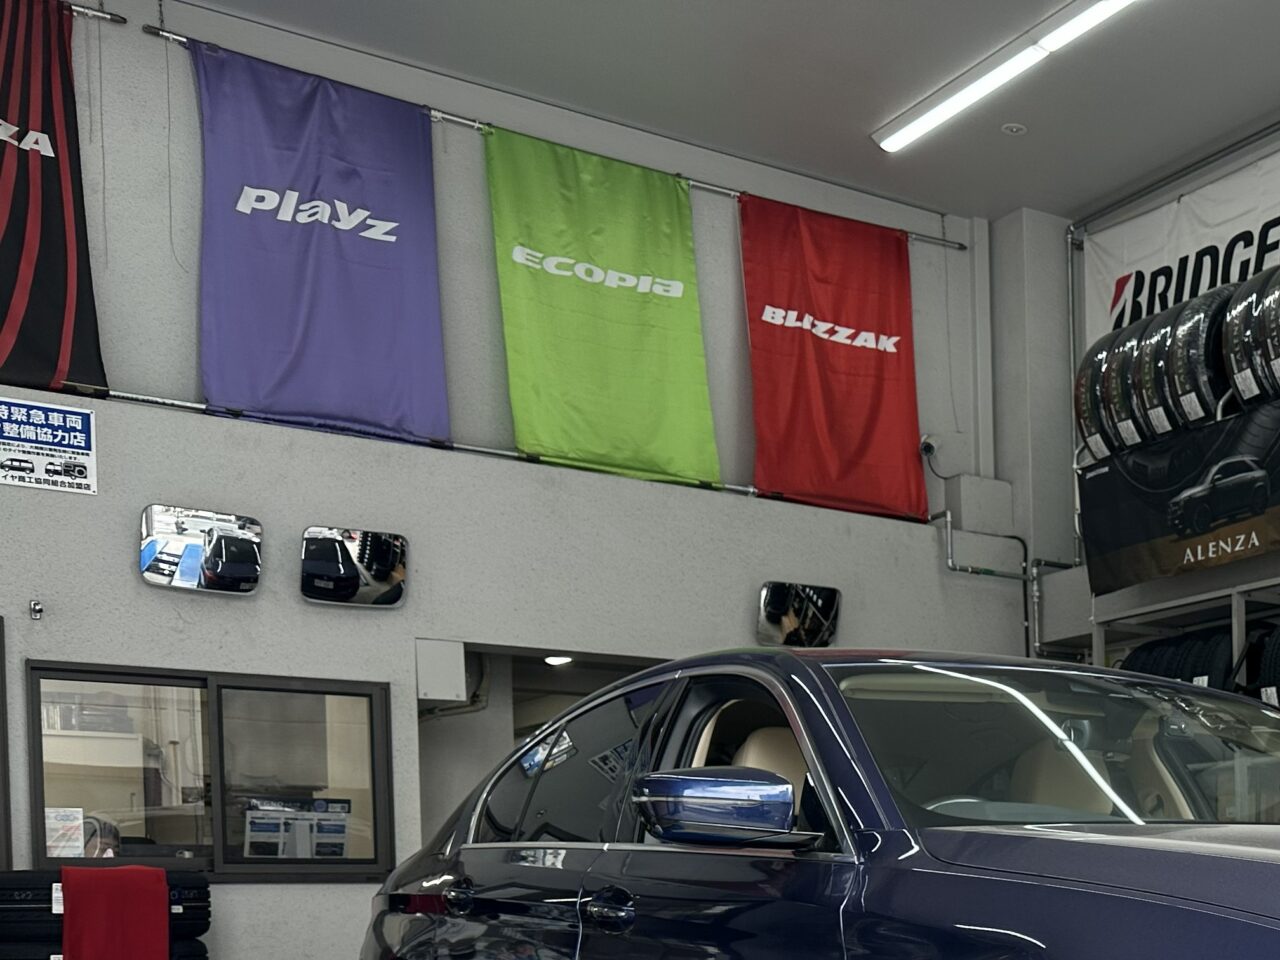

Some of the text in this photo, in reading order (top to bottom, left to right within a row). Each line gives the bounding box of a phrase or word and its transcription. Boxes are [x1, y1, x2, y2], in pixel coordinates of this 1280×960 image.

[761, 304, 902, 353] BLIZZAK
[0, 421, 87, 447] 整備協力店
[1183, 530, 1260, 564] ALENZA
